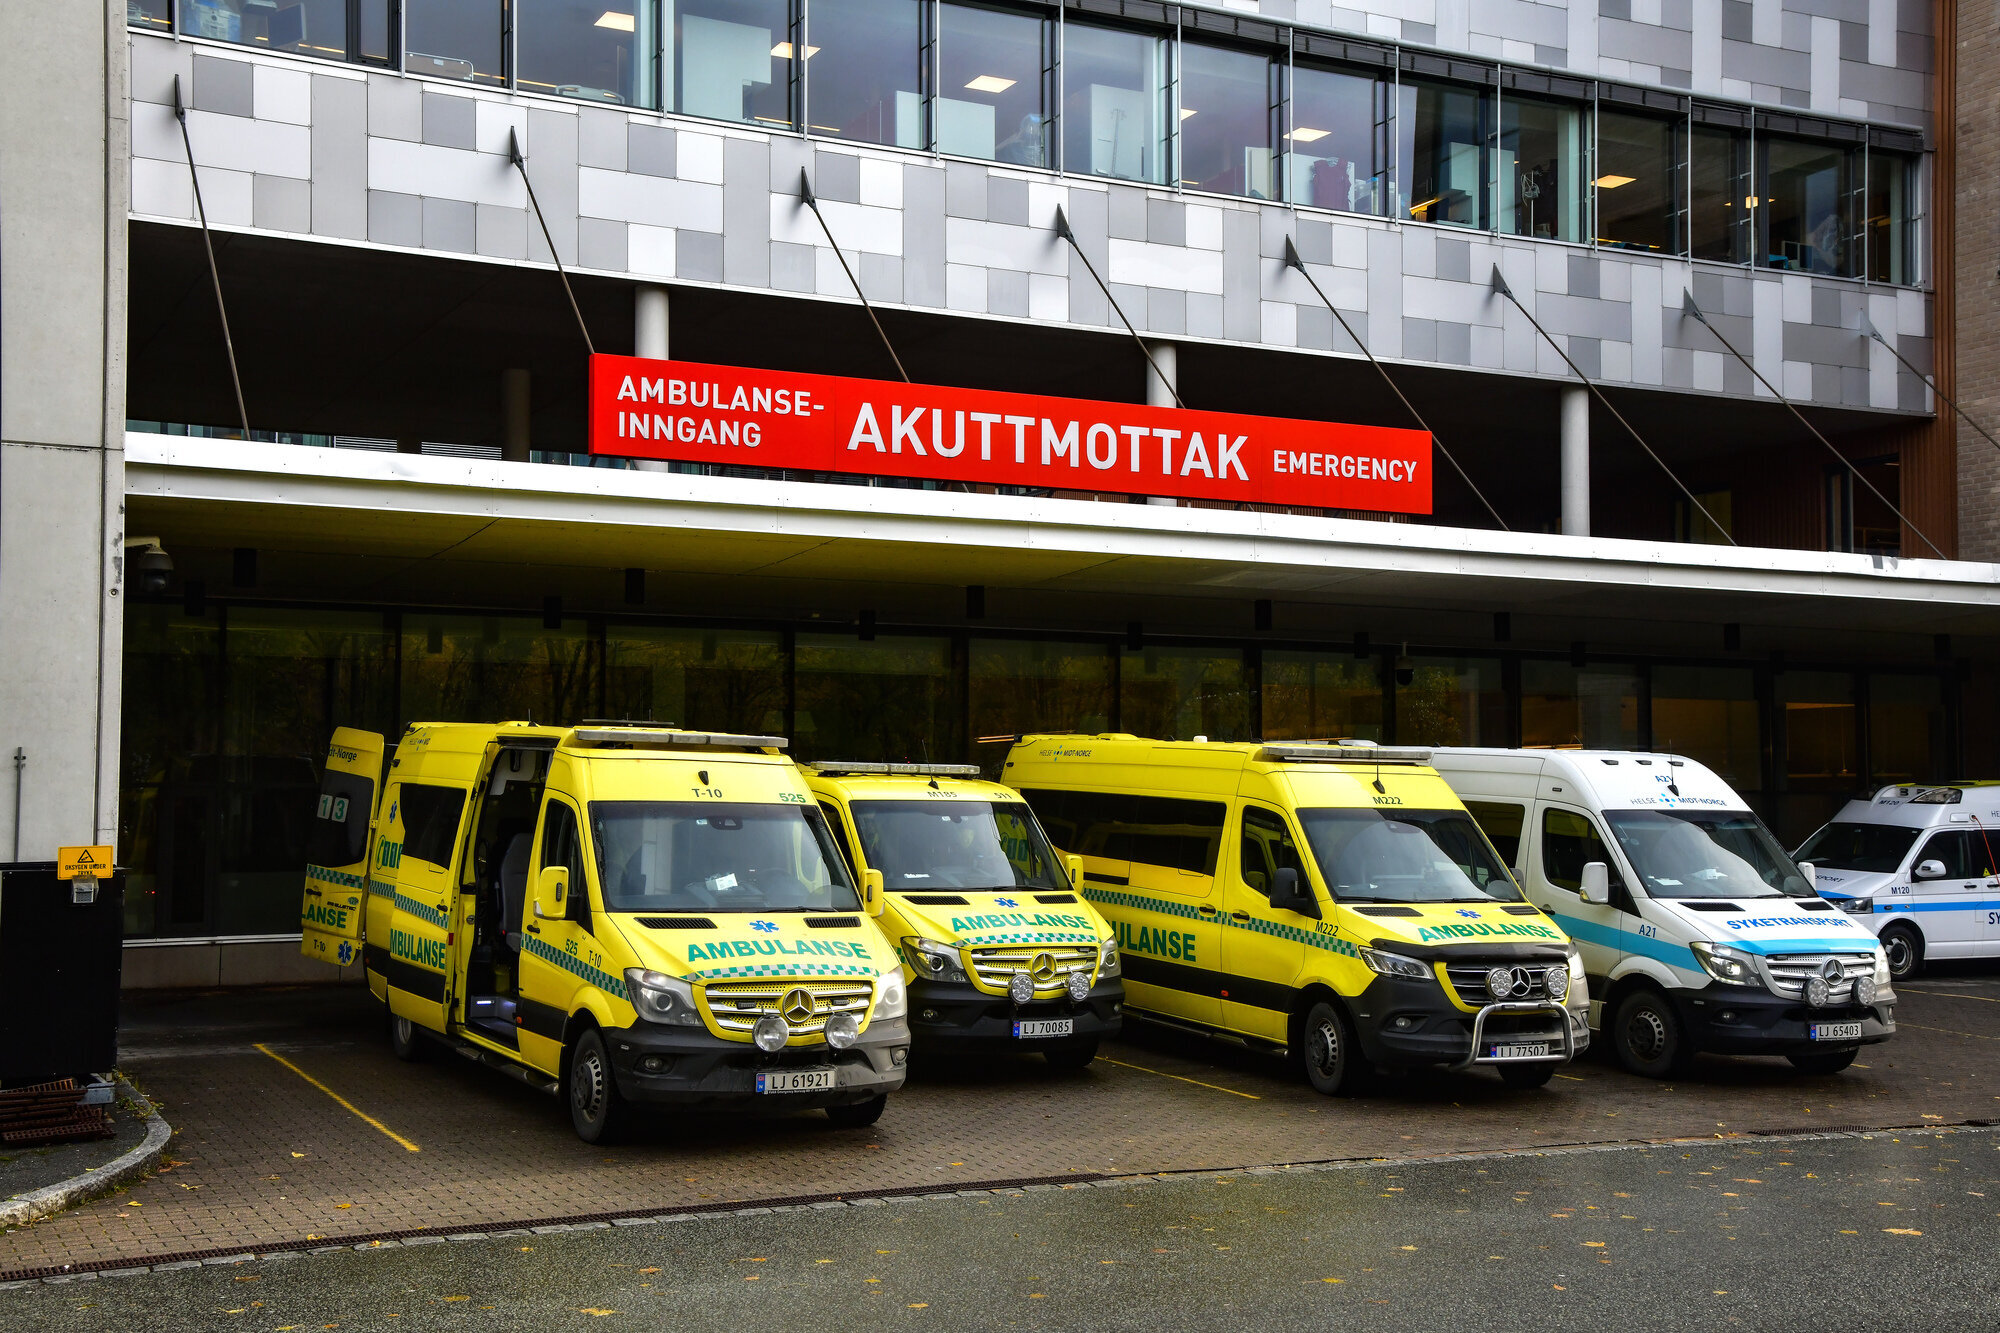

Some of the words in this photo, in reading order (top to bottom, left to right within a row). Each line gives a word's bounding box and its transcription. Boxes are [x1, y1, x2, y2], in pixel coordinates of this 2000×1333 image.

[616, 375, 825, 417] AMBULANSE-
[618, 411, 761, 448] INNGANG
[846, 401, 1250, 482] AKUTTMOTTAK
[1273, 449, 1418, 483] EMERGENCY
[691, 788, 723, 798] T-10
[779, 793, 807, 803] 525
[1372, 796, 1403, 805] M222
[1630, 797, 1657, 805] HELSE
[1891, 886, 1910, 895] M120
[951, 913, 1094, 932] AMBULANSE
[1315, 921, 1339, 937] M222
[1726, 917, 1854, 930] SYKETRANSPORT
[1418, 923, 1560, 942] AMBULANSE
[1638, 924, 1656, 938] A21
[565, 938, 578, 956] 525
[1105, 919, 1196, 962] ULANSE
[588, 949, 602, 968] T-10
[688, 939, 872, 962] AMBULANSE
[1023, 1023, 1035, 1034] LJ
[1039, 1021, 1069, 1034] 70085
[1819, 1026, 1829, 1037] LJ
[1833, 1025, 1859, 1036] 65403
[1516, 1046, 1545, 1057] 77502
[772, 1075, 786, 1089] LJ
[792, 1072, 829, 1088] 61921
